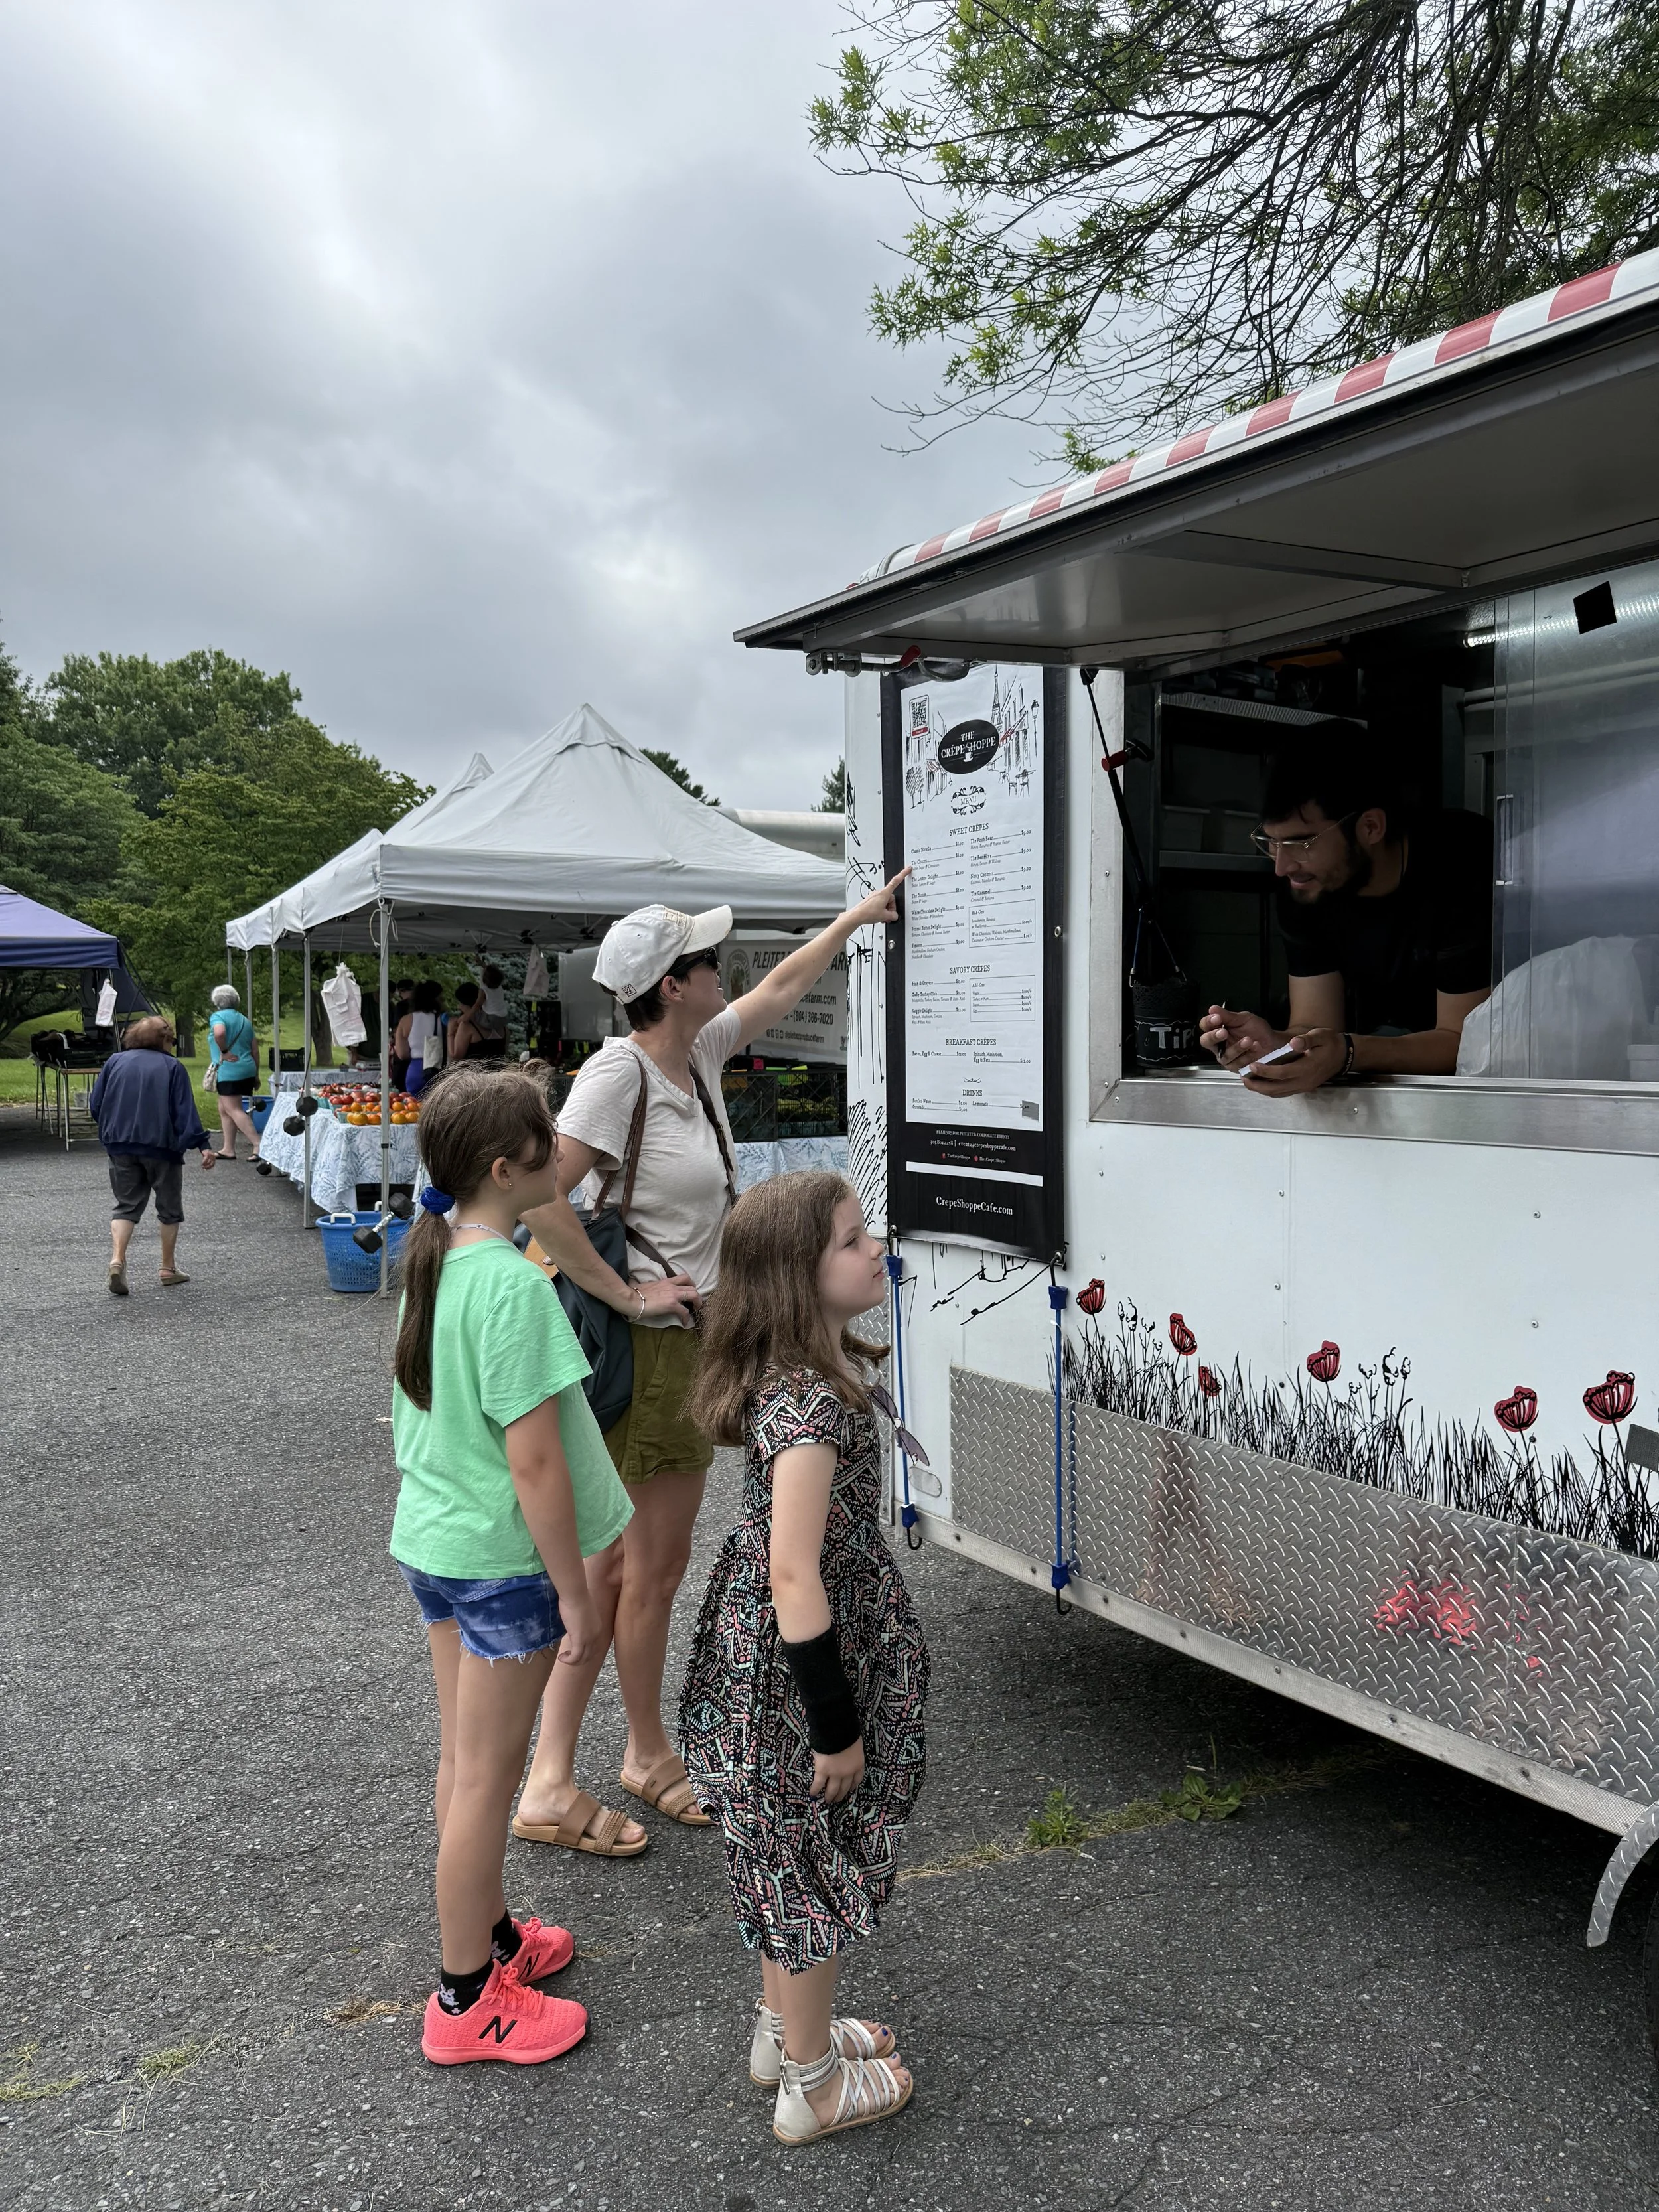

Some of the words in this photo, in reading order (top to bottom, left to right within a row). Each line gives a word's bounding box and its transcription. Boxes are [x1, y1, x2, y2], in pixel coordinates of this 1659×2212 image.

[961, 731, 975, 743] THE
[960, 796, 977, 806] MENU
[949, 827, 968, 836] SWEET
[936, 1196, 1013, 1215] CrepeShoppeCafe.com
[478, 2015, 518, 2044] N
